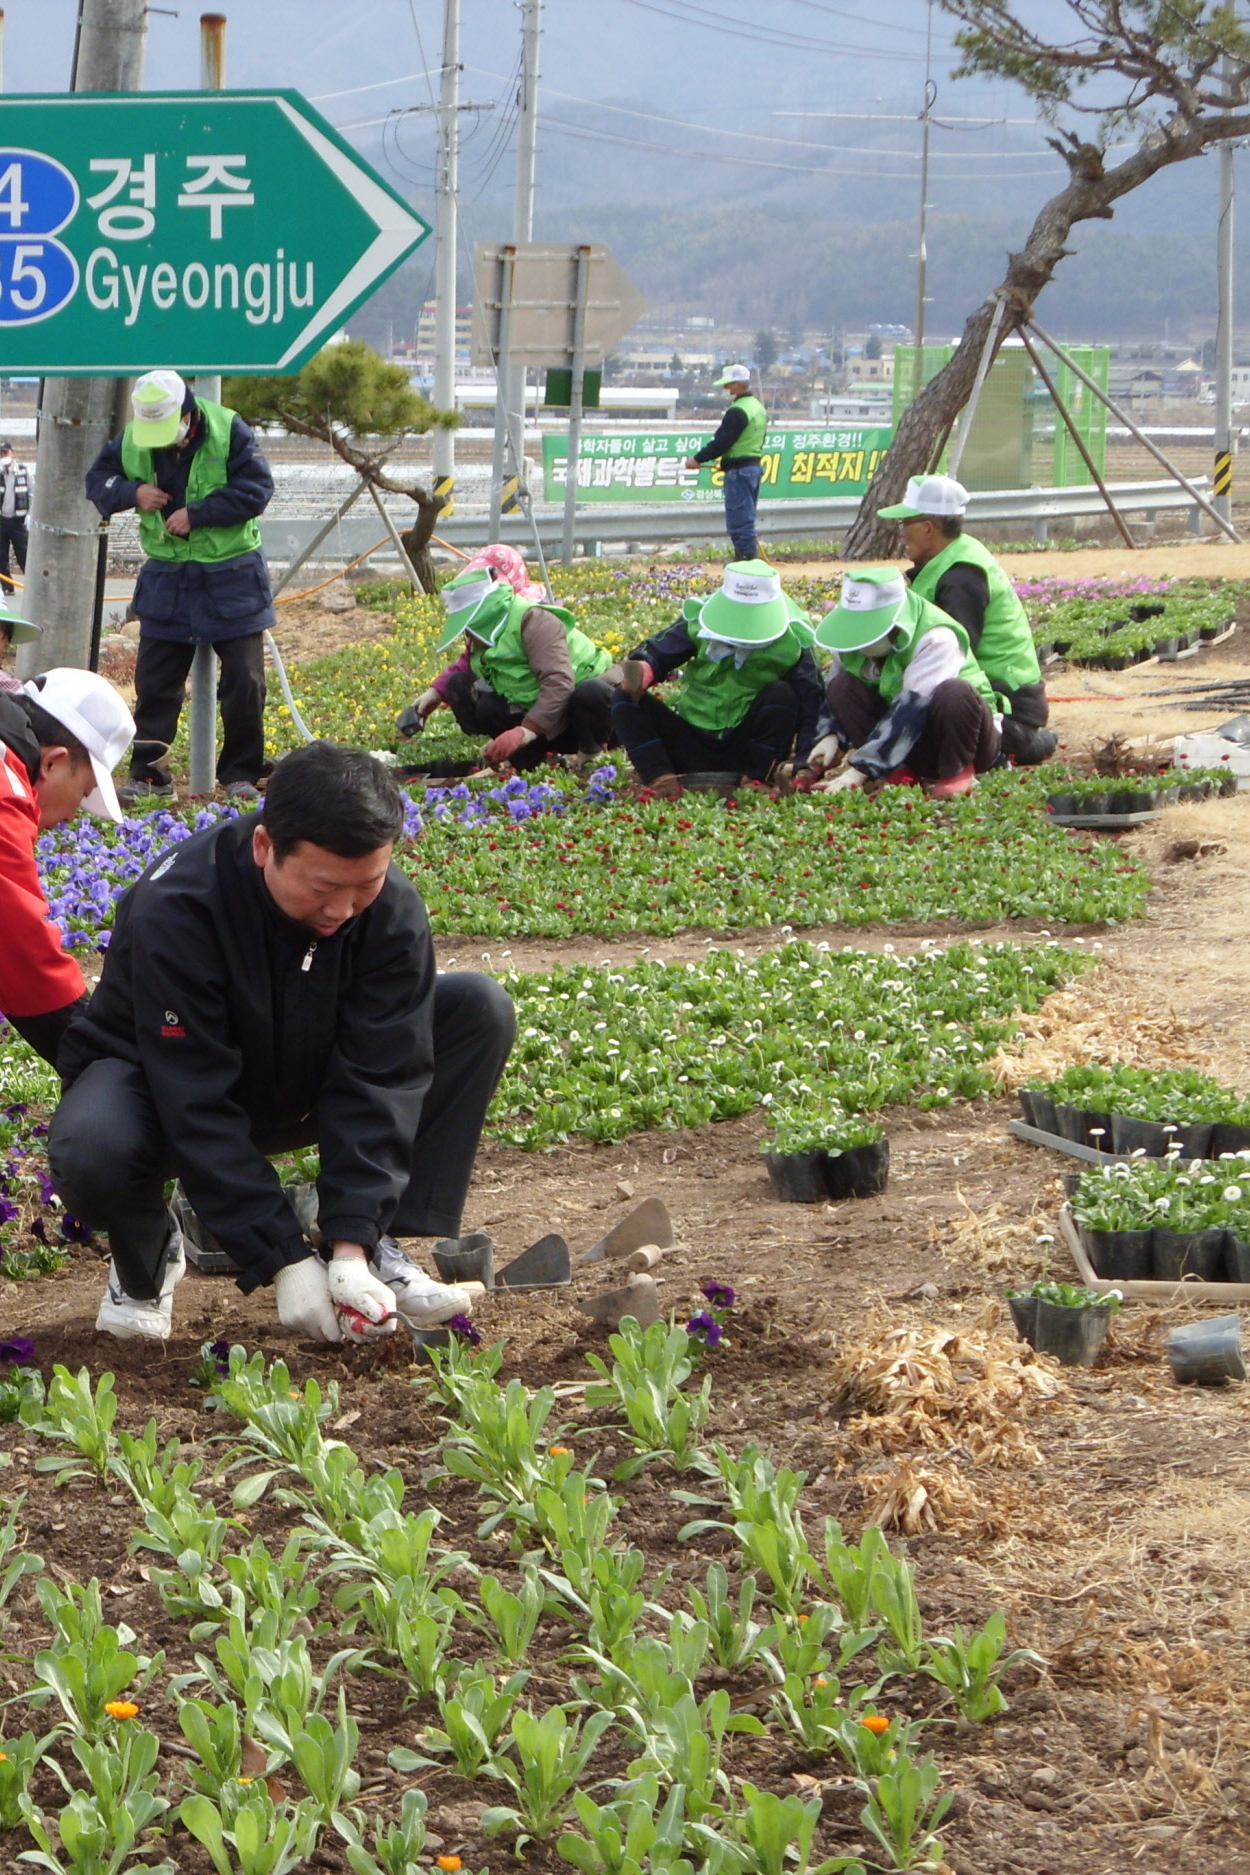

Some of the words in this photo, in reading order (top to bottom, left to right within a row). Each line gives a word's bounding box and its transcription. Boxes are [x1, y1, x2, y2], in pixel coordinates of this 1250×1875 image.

[86, 153, 255, 240] 경주
[85, 247, 314, 326] Gyeongju
[642, 437, 668, 453] 살고
[675, 437, 702, 452] 싶어
[696, 489, 726, 500] 경상북
